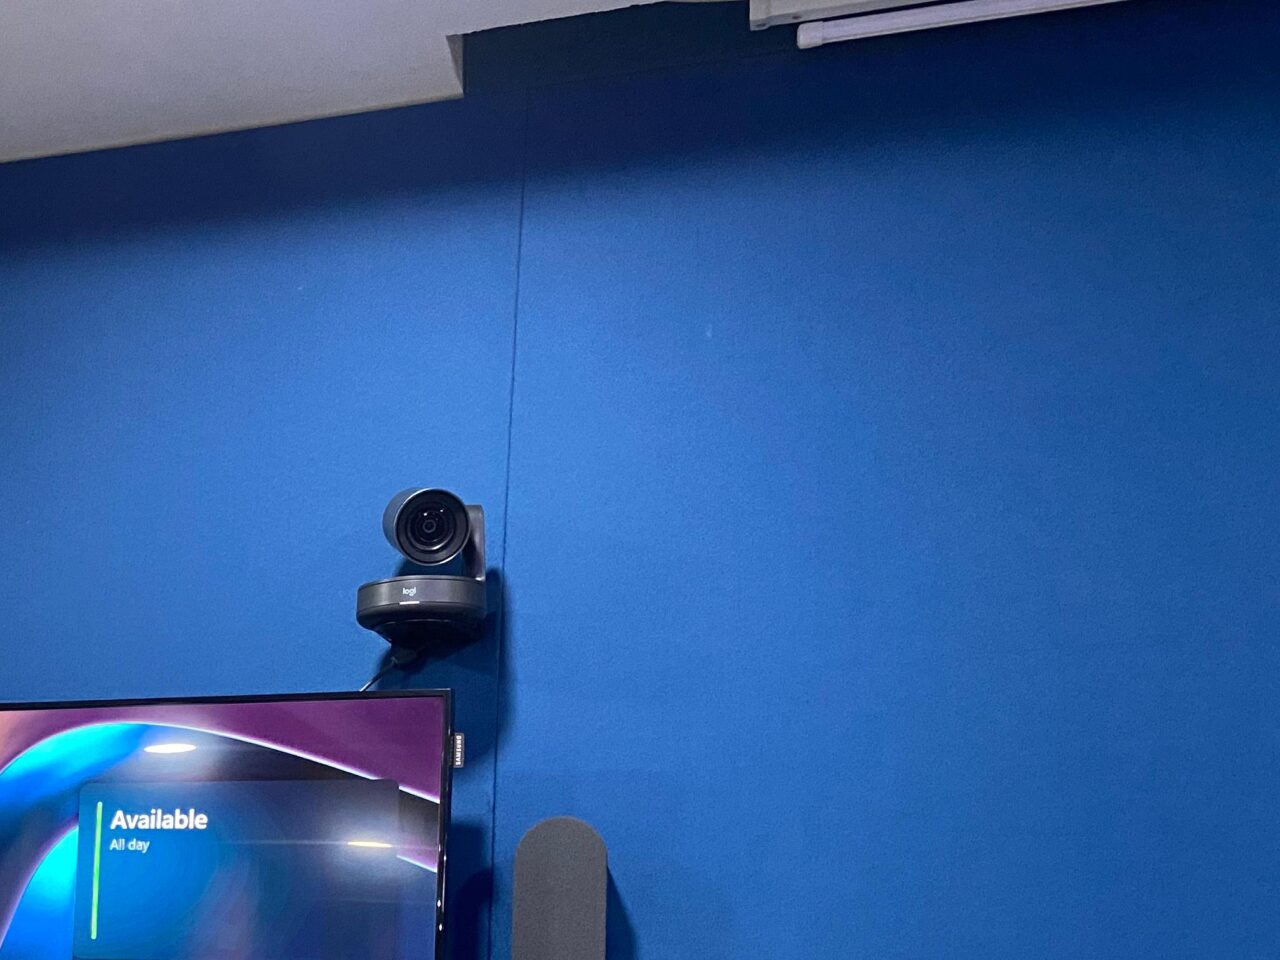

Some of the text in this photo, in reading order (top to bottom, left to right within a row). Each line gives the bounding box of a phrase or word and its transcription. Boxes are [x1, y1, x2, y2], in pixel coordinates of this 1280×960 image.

[110, 808, 208, 829] Available
[109, 838, 150, 853] All day
